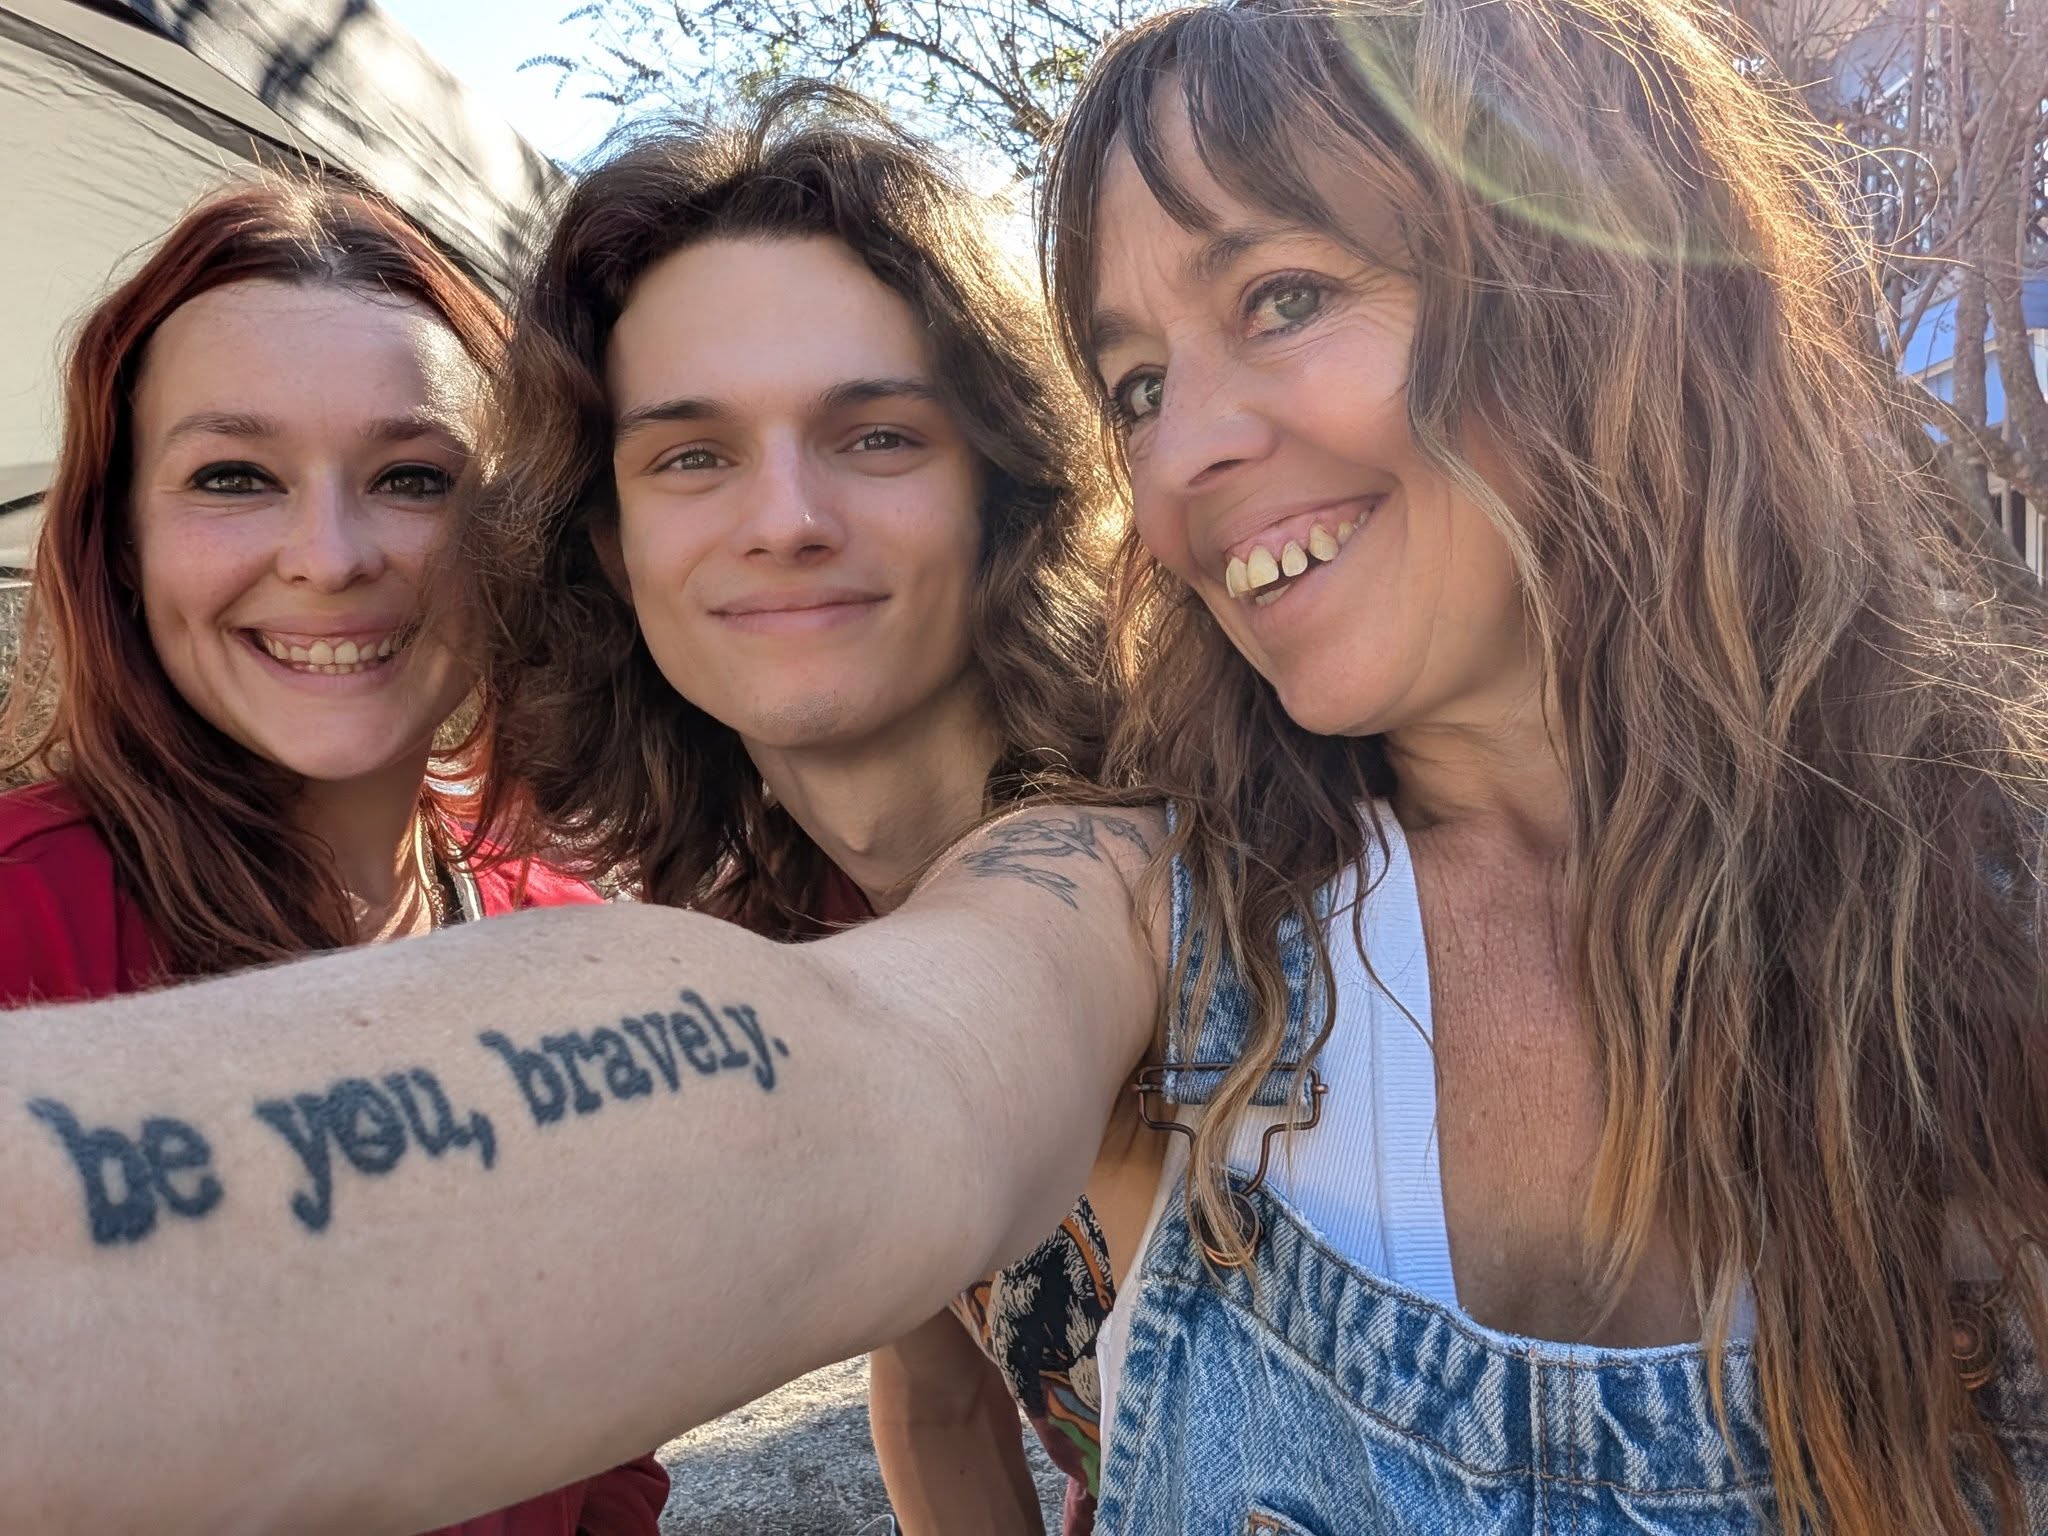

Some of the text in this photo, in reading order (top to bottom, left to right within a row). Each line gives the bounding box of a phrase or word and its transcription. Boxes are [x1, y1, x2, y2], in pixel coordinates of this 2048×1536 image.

[26, 989, 790, 1246] be you, bravely.
